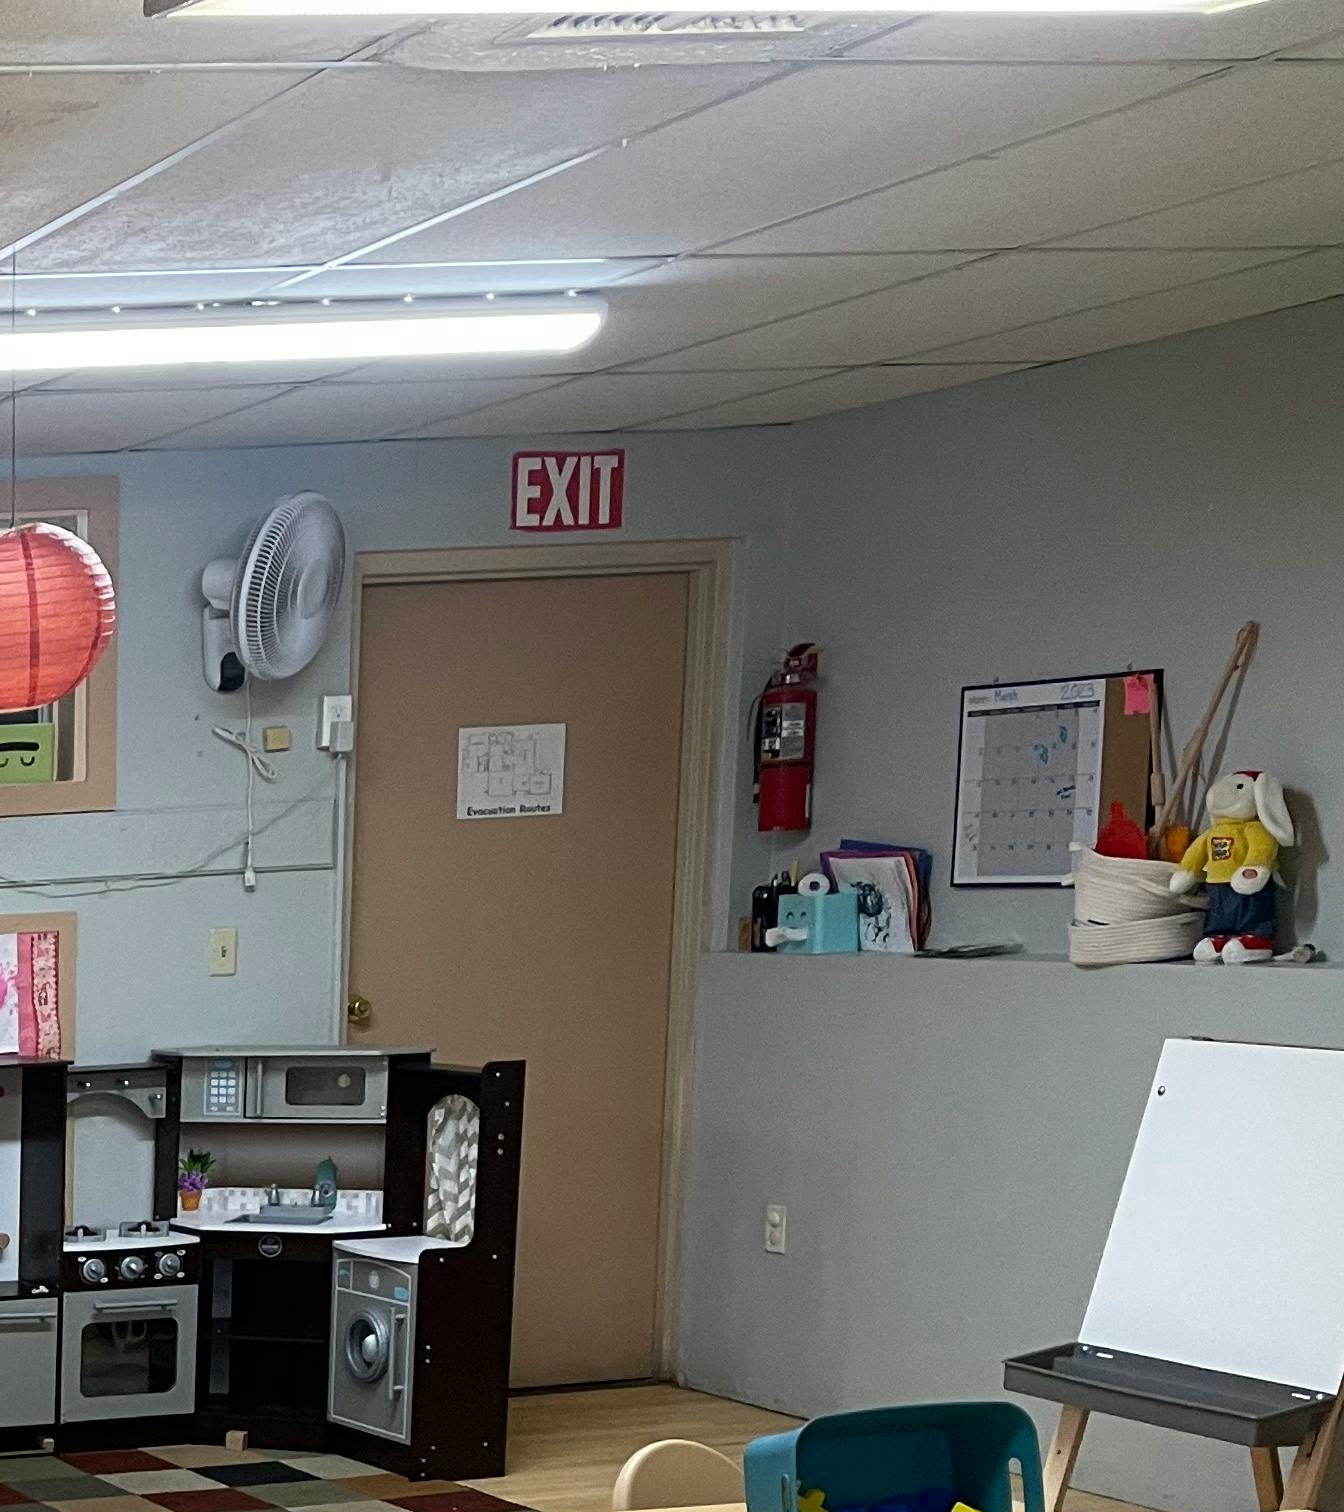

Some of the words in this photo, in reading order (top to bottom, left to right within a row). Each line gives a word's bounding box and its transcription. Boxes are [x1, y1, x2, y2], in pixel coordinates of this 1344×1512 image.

[516, 455, 618, 527] EXIT
[467, 806, 516, 816] Evacuation
[519, 804, 551, 813] Routes
